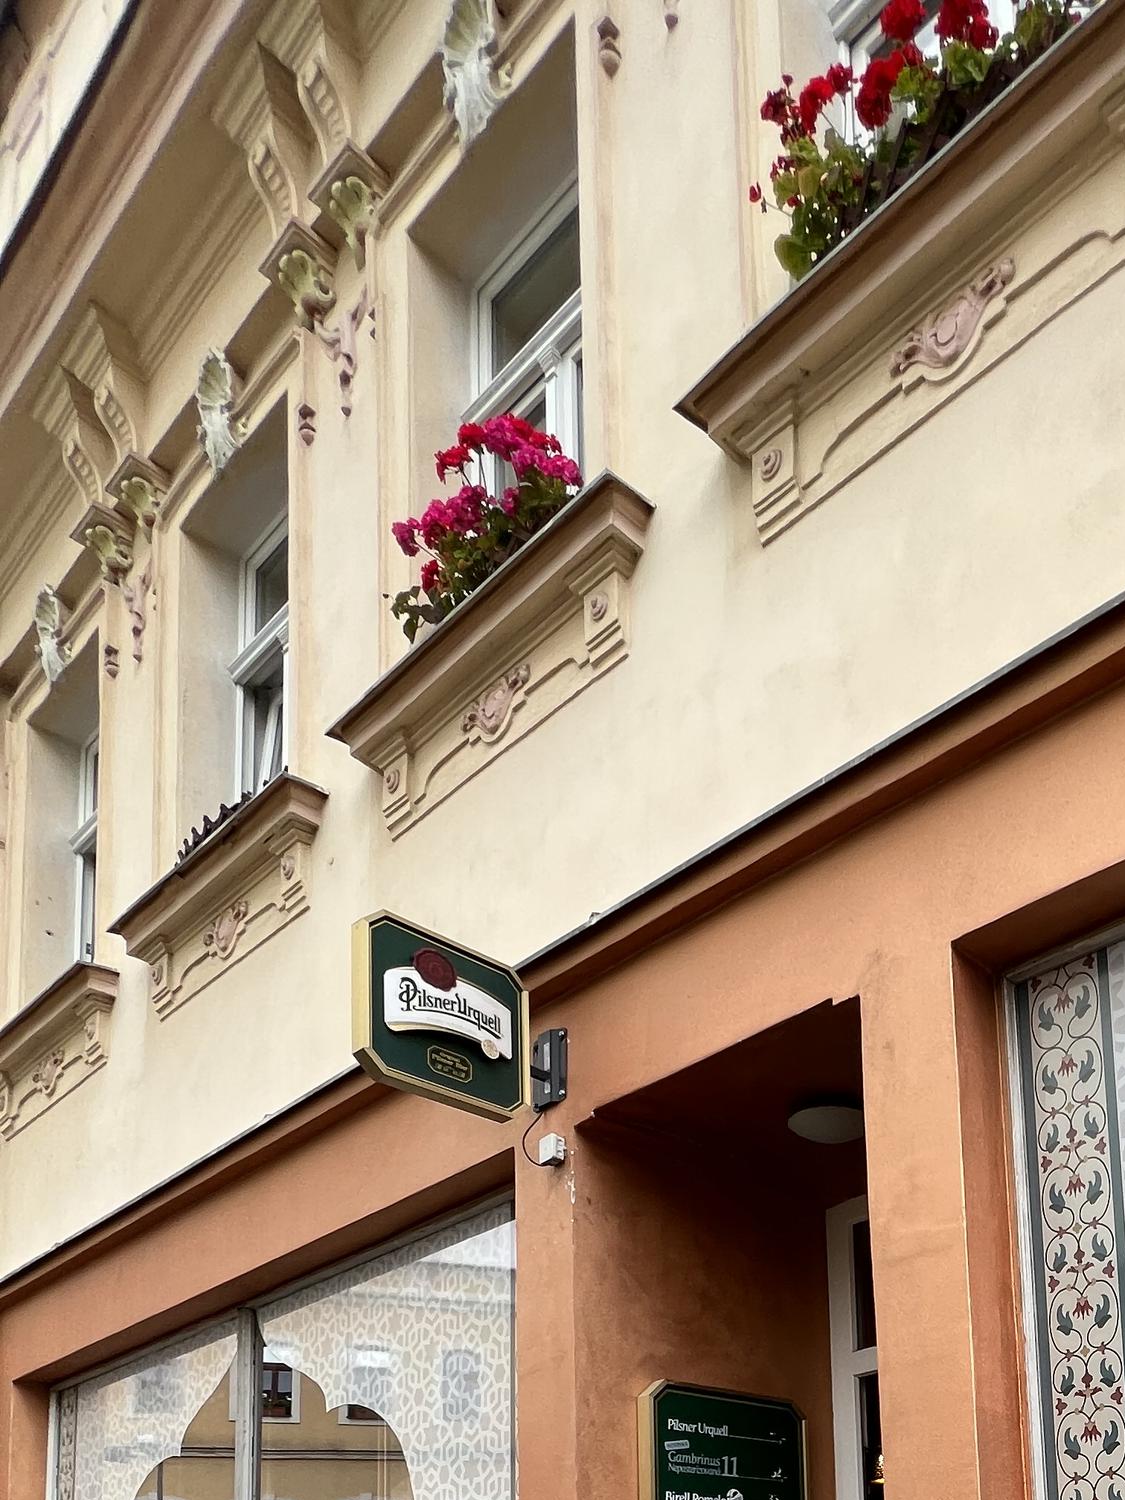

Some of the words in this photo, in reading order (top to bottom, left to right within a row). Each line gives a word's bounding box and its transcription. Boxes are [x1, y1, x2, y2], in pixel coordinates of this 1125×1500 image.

[398, 976, 457, 1011] Pilsner
[455, 993, 502, 1034] Urquell
[667, 1418, 697, 1432] Pilsner
[698, 1422, 729, 1437] Urquell
[667, 1450, 721, 1467] Gambrinus
[721, 1455, 739, 1477] 11
